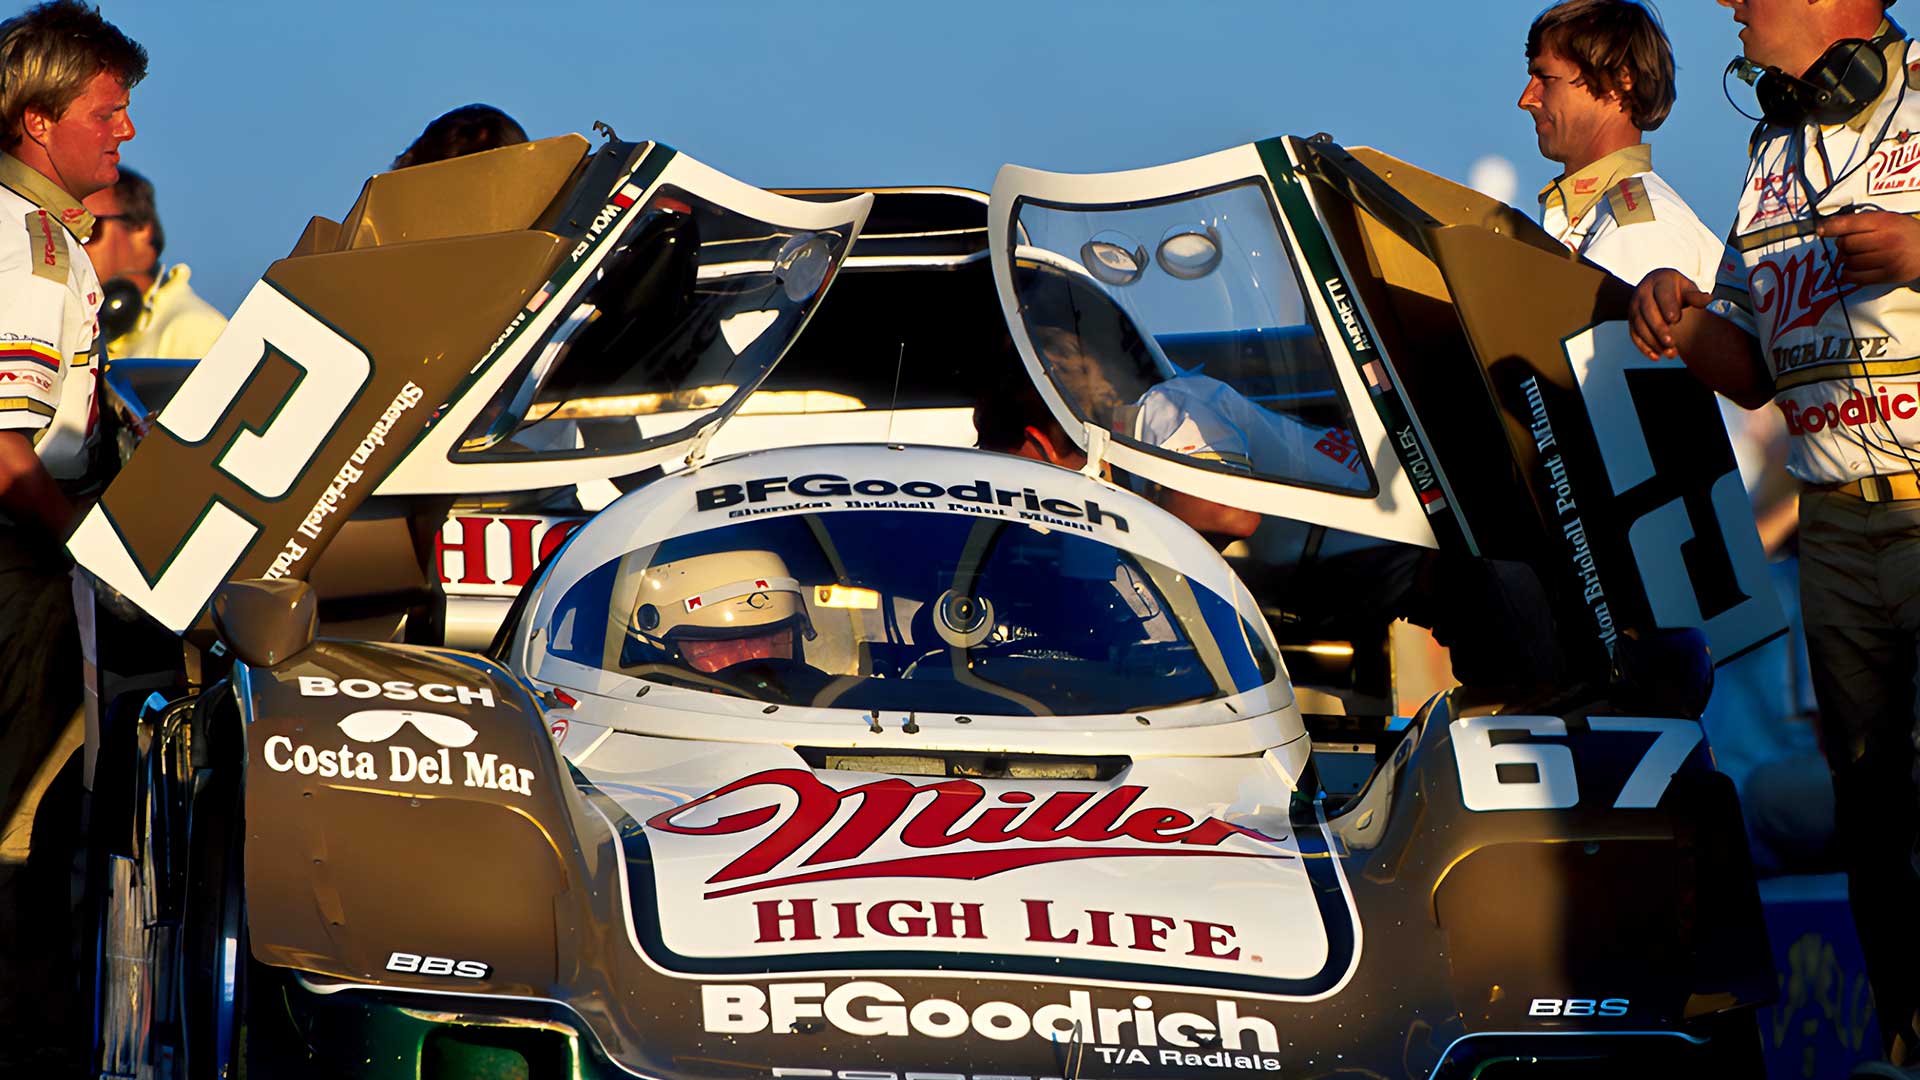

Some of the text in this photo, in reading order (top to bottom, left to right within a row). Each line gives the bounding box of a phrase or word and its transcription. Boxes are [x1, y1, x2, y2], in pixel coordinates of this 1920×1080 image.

[1520, 376, 1556, 453] Miami
[261, 381, 424, 581] Sheraton Brickell Poin
[1396, 425, 1434, 491] WOLLEK
[1543, 453, 1577, 515] Point
[696, 473, 1129, 533] BFGoodrich
[1563, 517, 1604, 605] Brickell
[298, 676, 496, 708] BOSCH
[264, 736, 535, 796] Costa Del Mar
[1449, 715, 1704, 812] 67
[646, 768, 1288, 885] Miller
[753, 898, 1243, 962] HIGH LIFE
[386, 952, 492, 979] BBS
[702, 981, 1280, 1054] BFGoodrich
[1528, 999, 1630, 1017] BBS
[1095, 1047, 1281, 1072] T/A Radials
